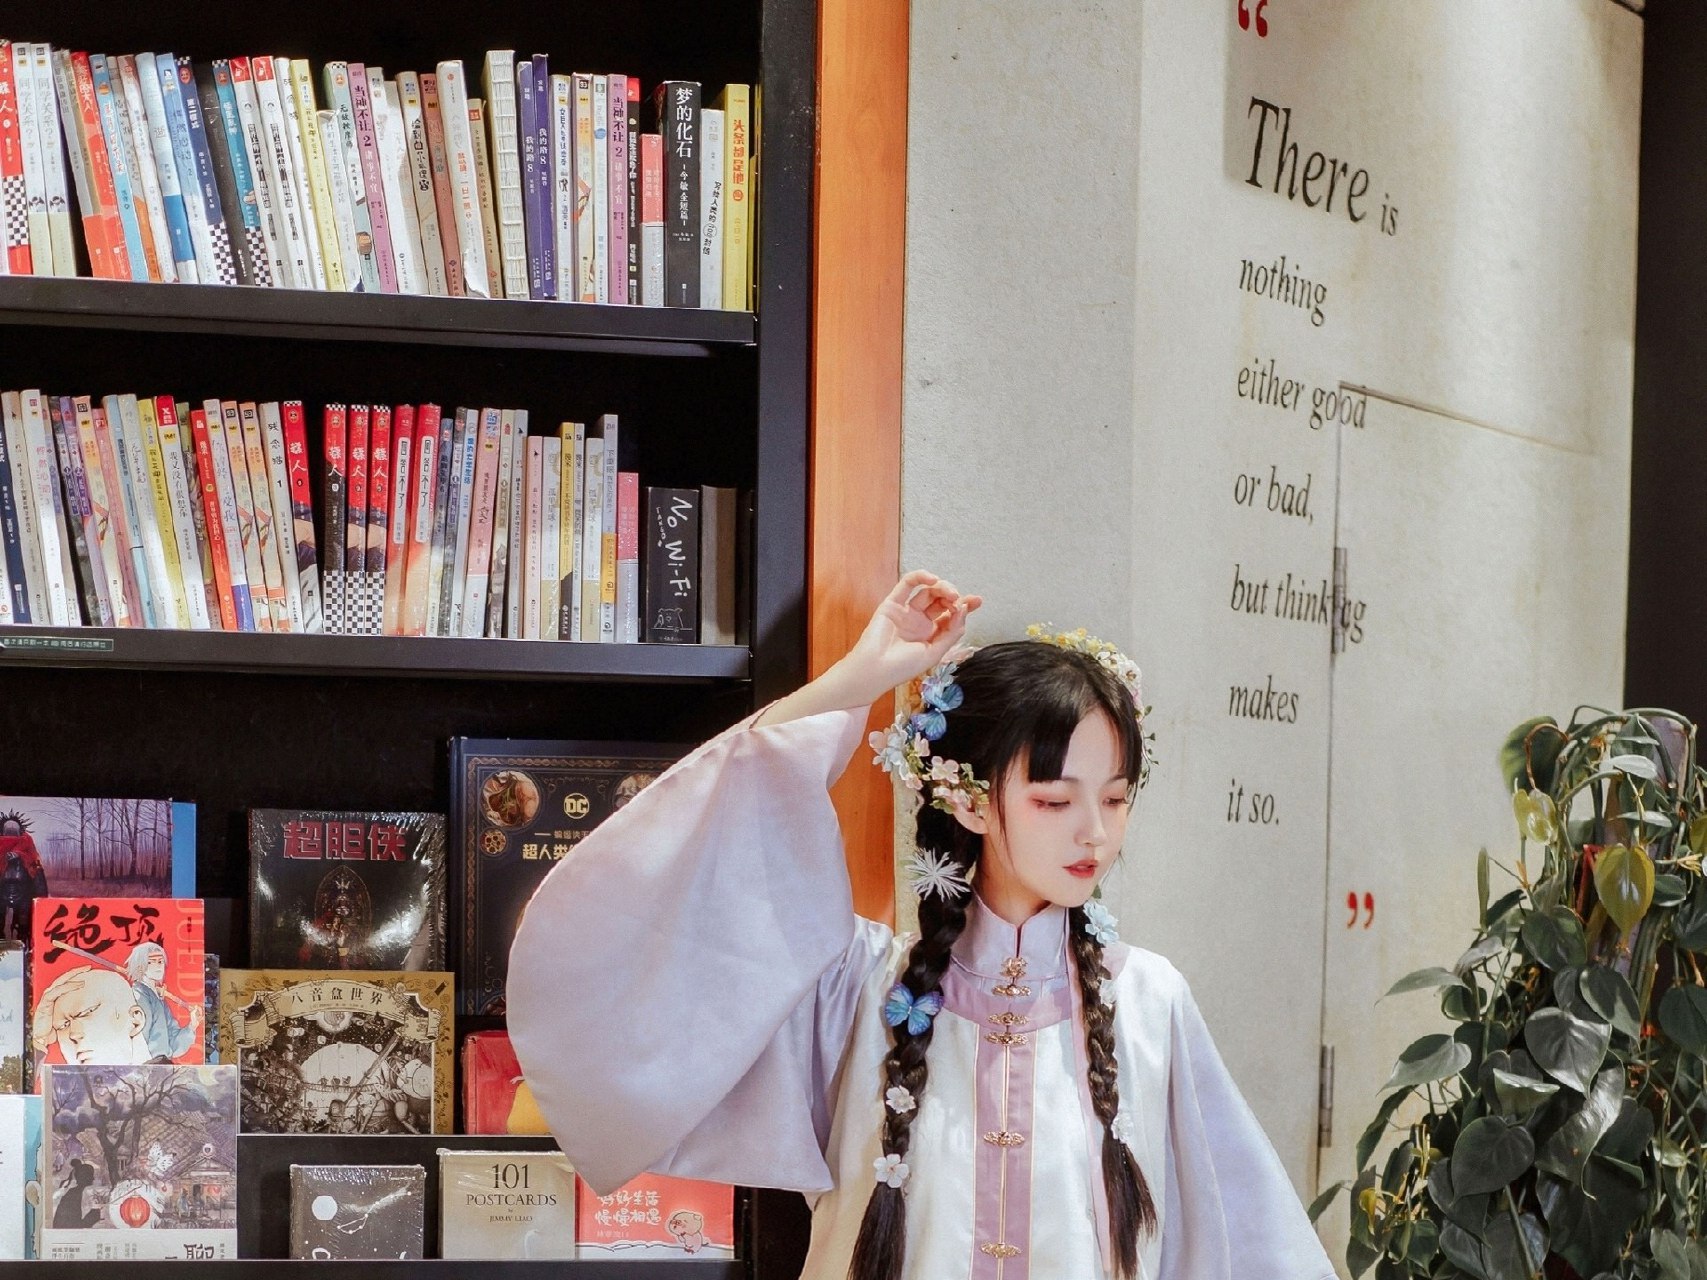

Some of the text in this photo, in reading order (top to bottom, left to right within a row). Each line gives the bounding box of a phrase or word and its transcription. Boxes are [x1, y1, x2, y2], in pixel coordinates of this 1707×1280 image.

[363, 136, 372, 147] 2
[675, 87, 693, 158] 梦的化石
[615, 146, 623, 158] 2
[1245, 96, 1398, 236] There is
[1239, 256, 1327, 326] nothing
[1237, 358, 1367, 430] either good
[1234, 465, 1314, 524] or bad,
[665, 496, 693, 597] No Wi-Fi
[1231, 563, 1268, 613] but
[1228, 674, 1299, 724] makes
[1226, 778, 1280, 825] it so.
[466, 1194, 557, 1206] POSTCARDS
[492, 1163, 531, 1189] 101
